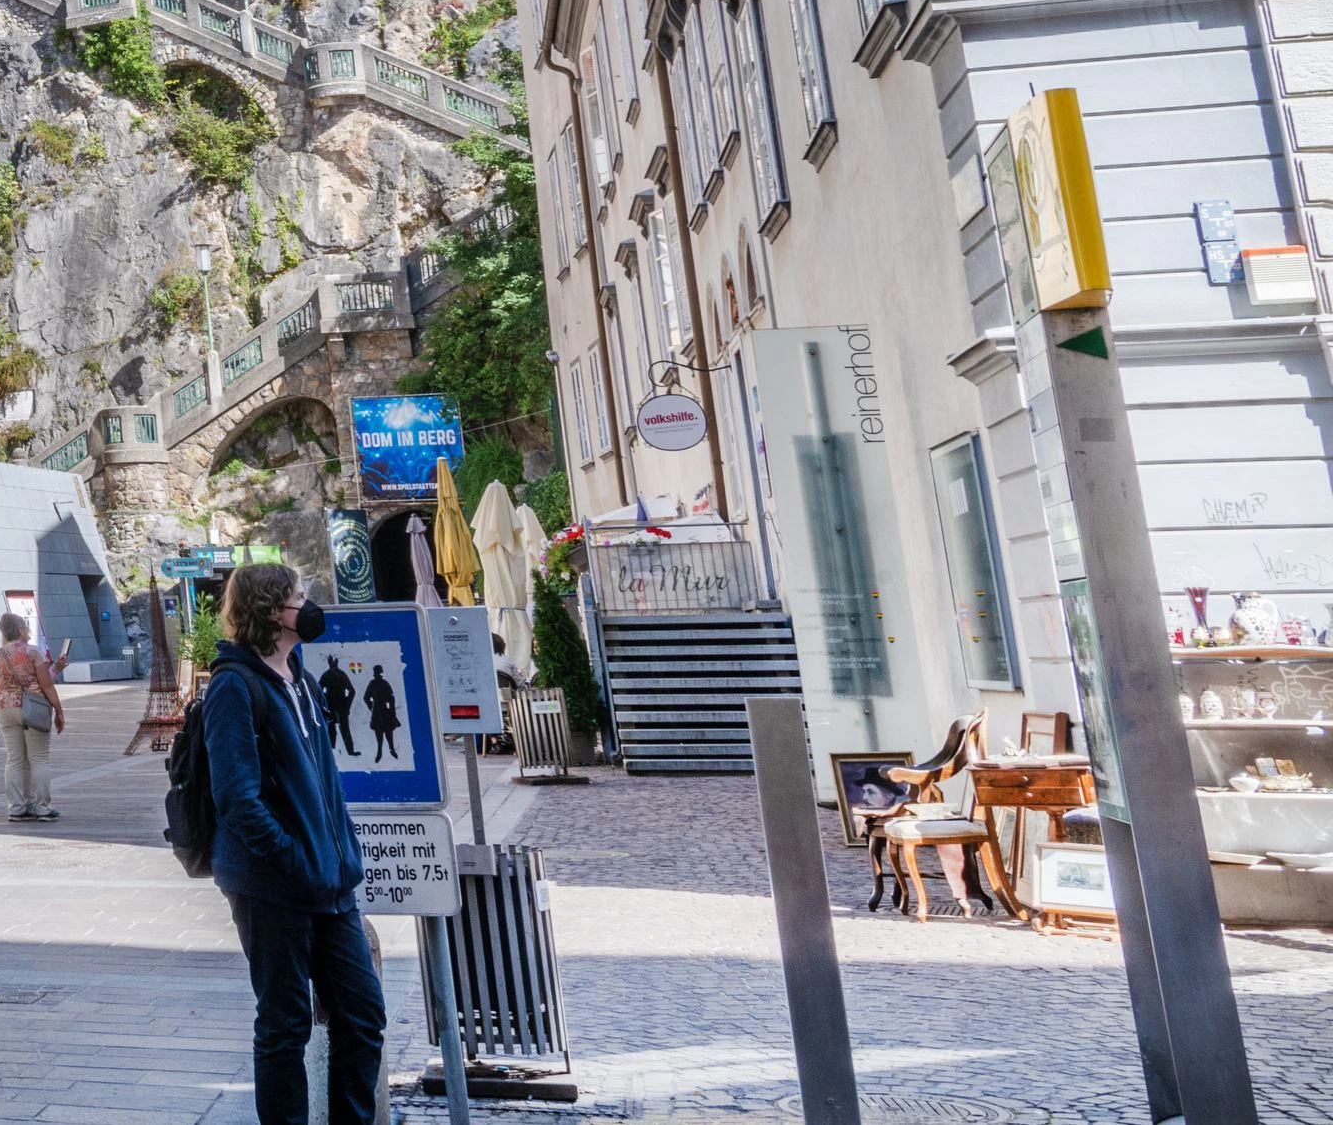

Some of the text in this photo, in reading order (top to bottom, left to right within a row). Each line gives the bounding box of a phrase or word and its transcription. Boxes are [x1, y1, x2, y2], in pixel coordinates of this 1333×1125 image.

[837, 324, 886, 444] reinerhof
[361, 429, 457, 448] DOM IM BERG
[618, 564, 730, 593] la Mur
[412, 841, 436, 858] mit
[396, 864, 418, 881] bis
